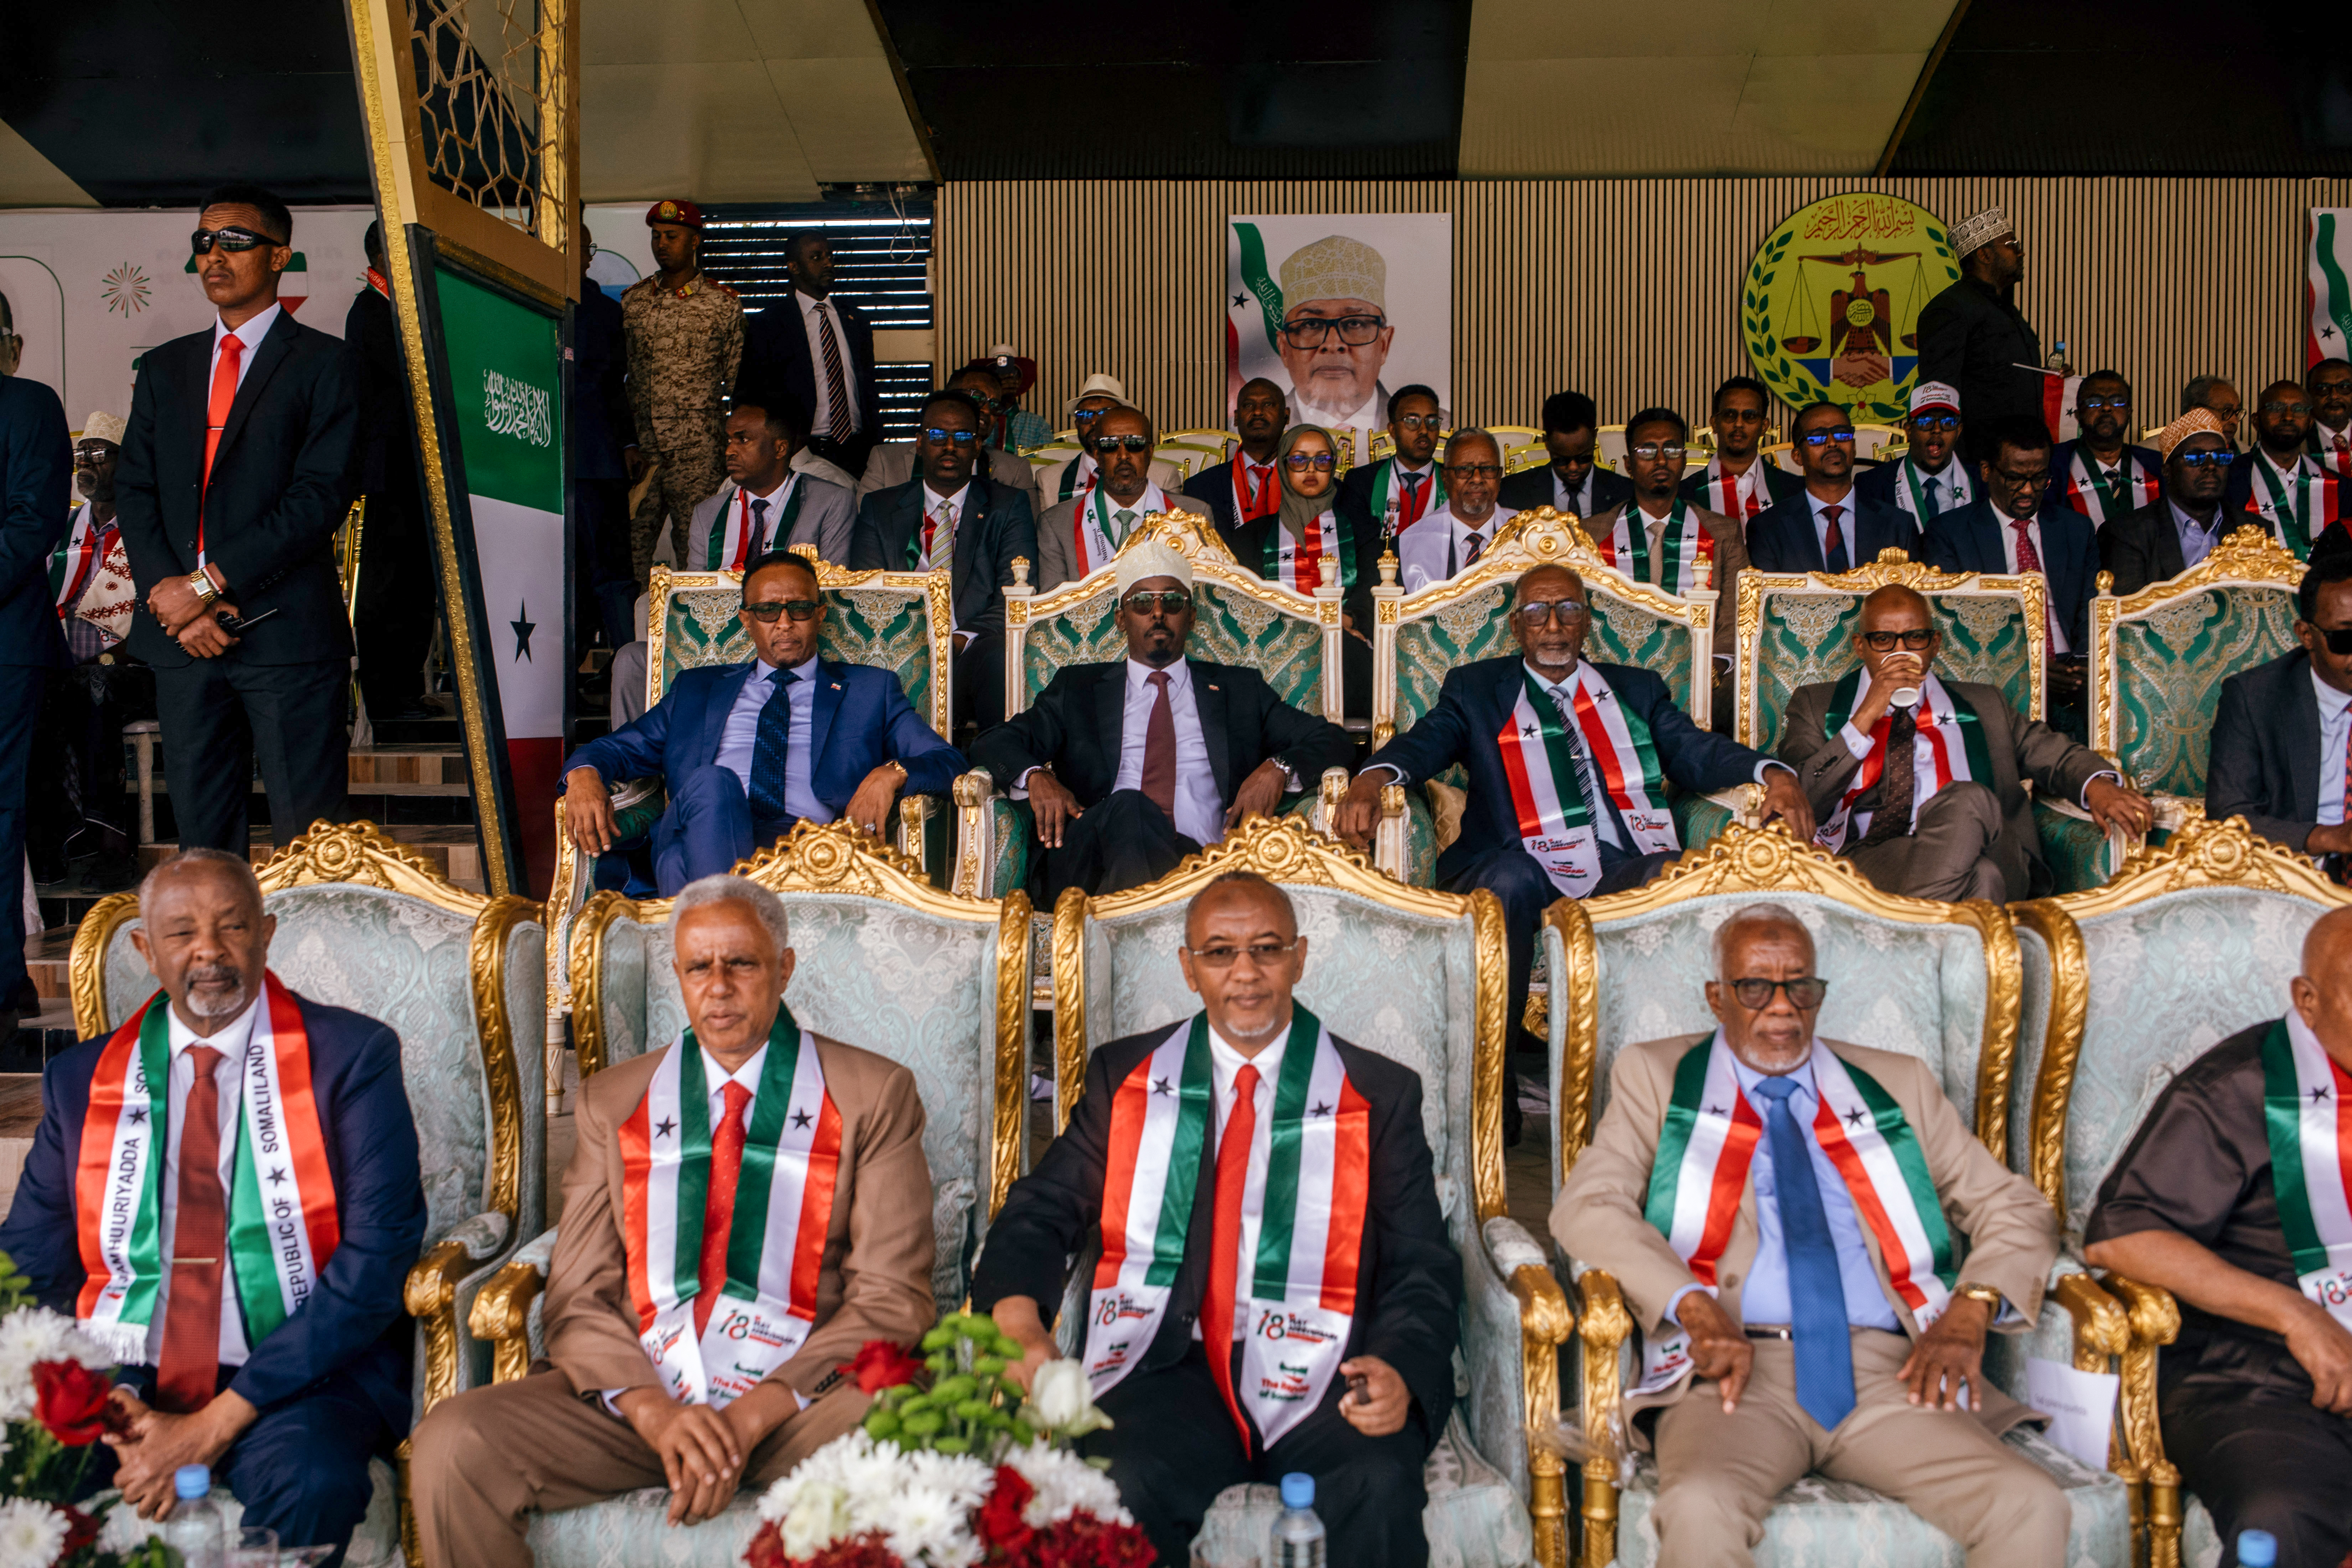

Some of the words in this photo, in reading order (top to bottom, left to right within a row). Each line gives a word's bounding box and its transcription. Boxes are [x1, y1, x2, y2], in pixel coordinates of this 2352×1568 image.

[1098, 534, 1108, 561] National
[1629, 814, 1645, 832] 18
[1531, 839, 1550, 853] 18
[249, 1044, 279, 1154] SOMALILAND
[273, 1197, 291, 1219] OF
[2314, 1279, 2346, 1308] 18
[719, 1309, 750, 1340] 18
[1095, 1297, 1117, 1326] 18
[1257, 1309, 1285, 1340] 18
